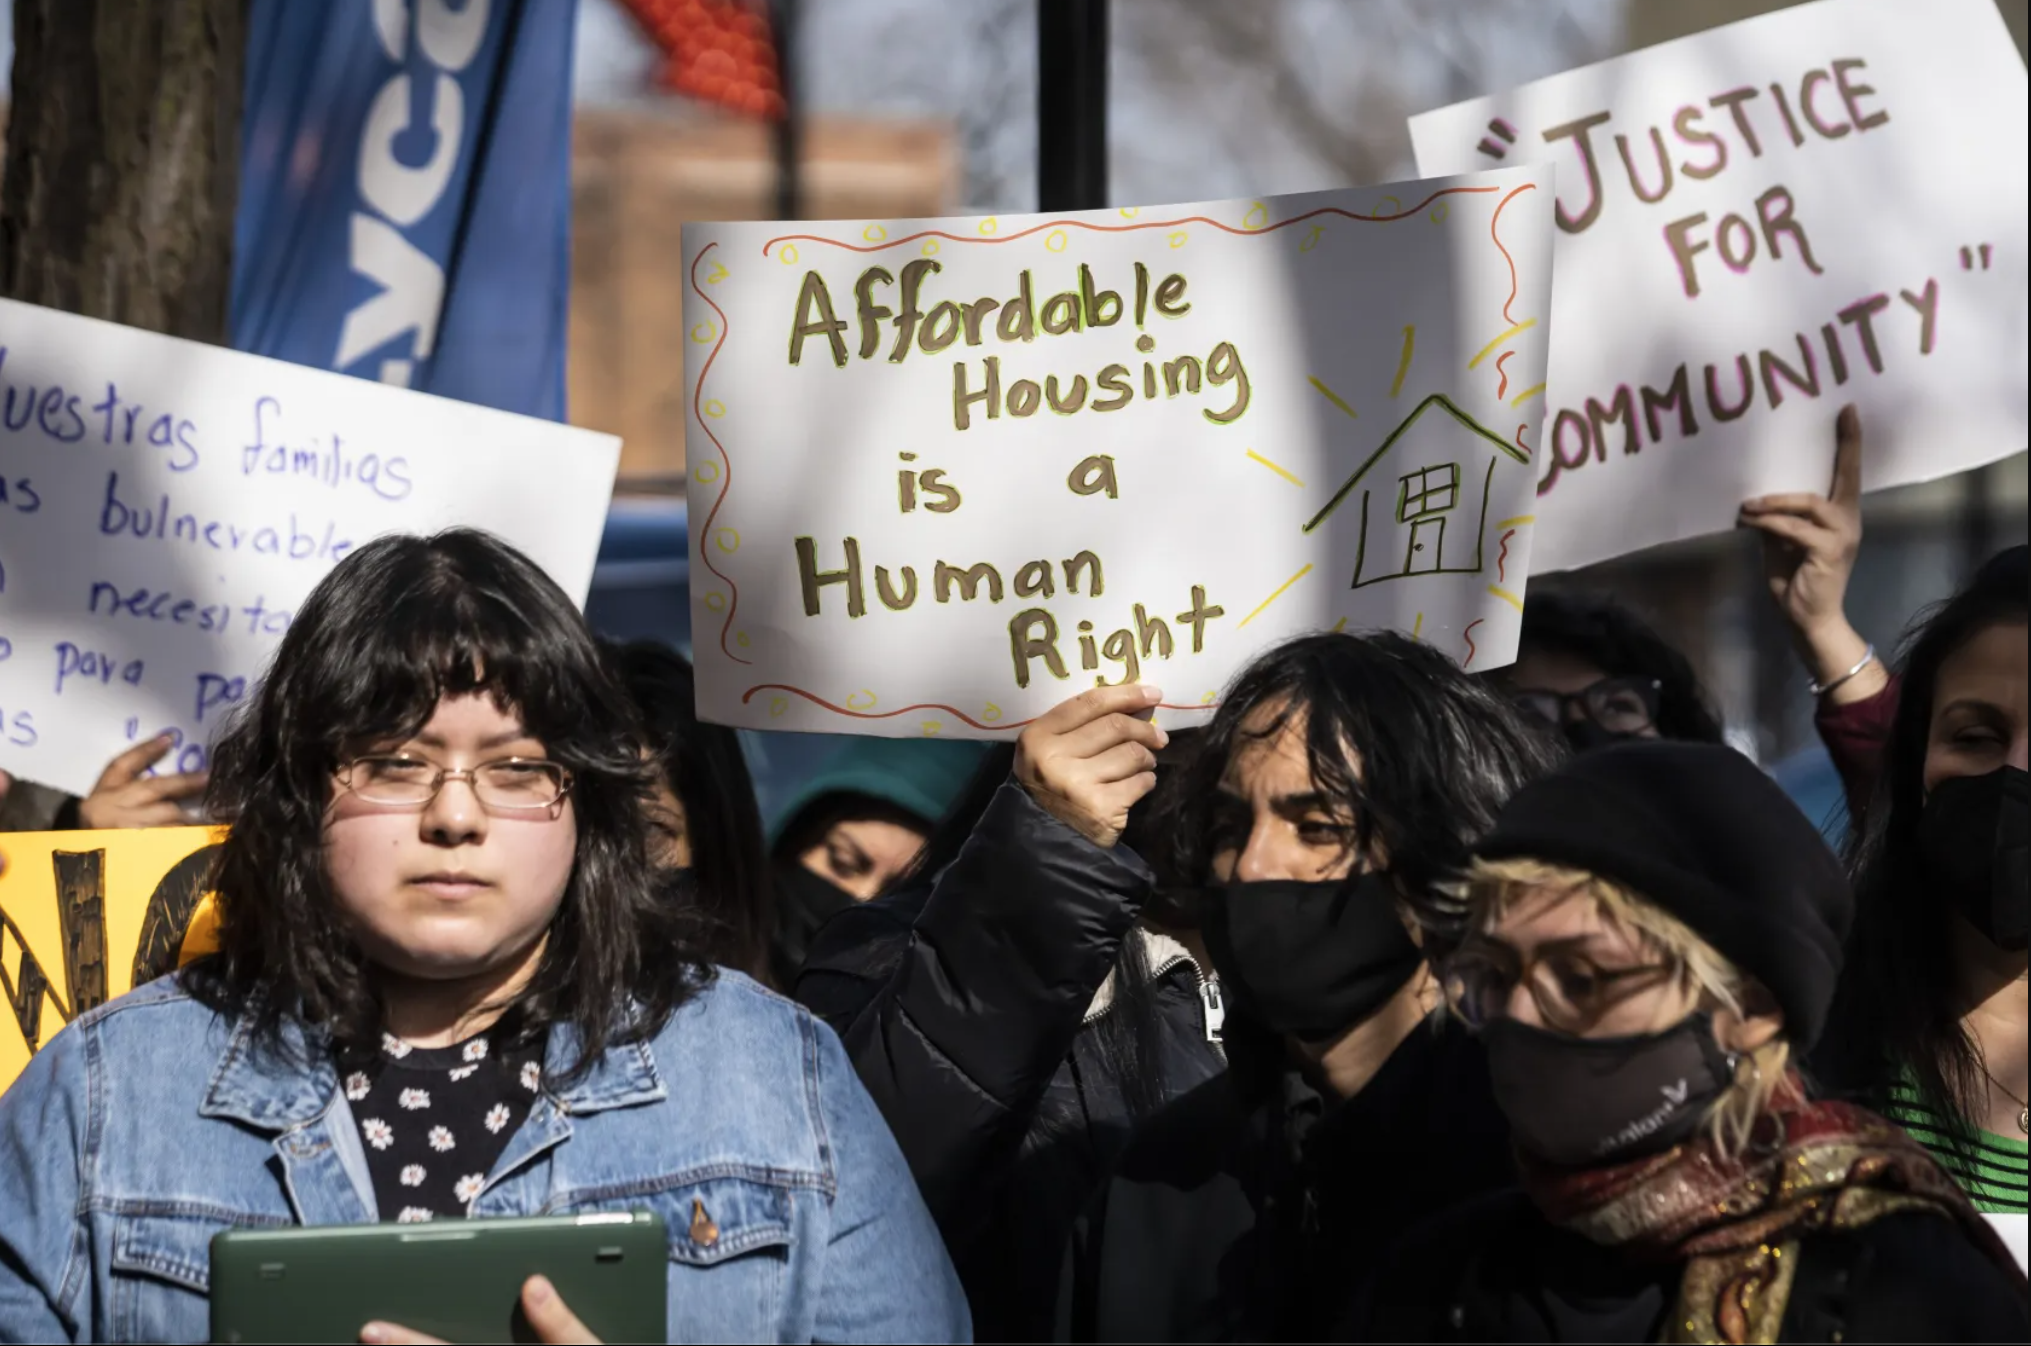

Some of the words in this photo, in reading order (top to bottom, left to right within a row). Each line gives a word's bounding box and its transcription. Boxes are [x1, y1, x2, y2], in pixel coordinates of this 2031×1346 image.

[1662, 185, 1824, 299] FOR
[788, 257, 1192, 368] Affordable
[952, 333, 1251, 431] Housing
[1537, 242, 1992, 496] OMMUNITY"
[0, 345, 199, 472] uestras
[243, 395, 414, 502] familias
[898, 450, 963, 514] is
[1066, 453, 1119, 499] a
[89, 575, 290, 635] necesita
[794, 536, 1105, 618] Human
[54, 641, 145, 694] para
[1009, 584, 1225, 689] Right
